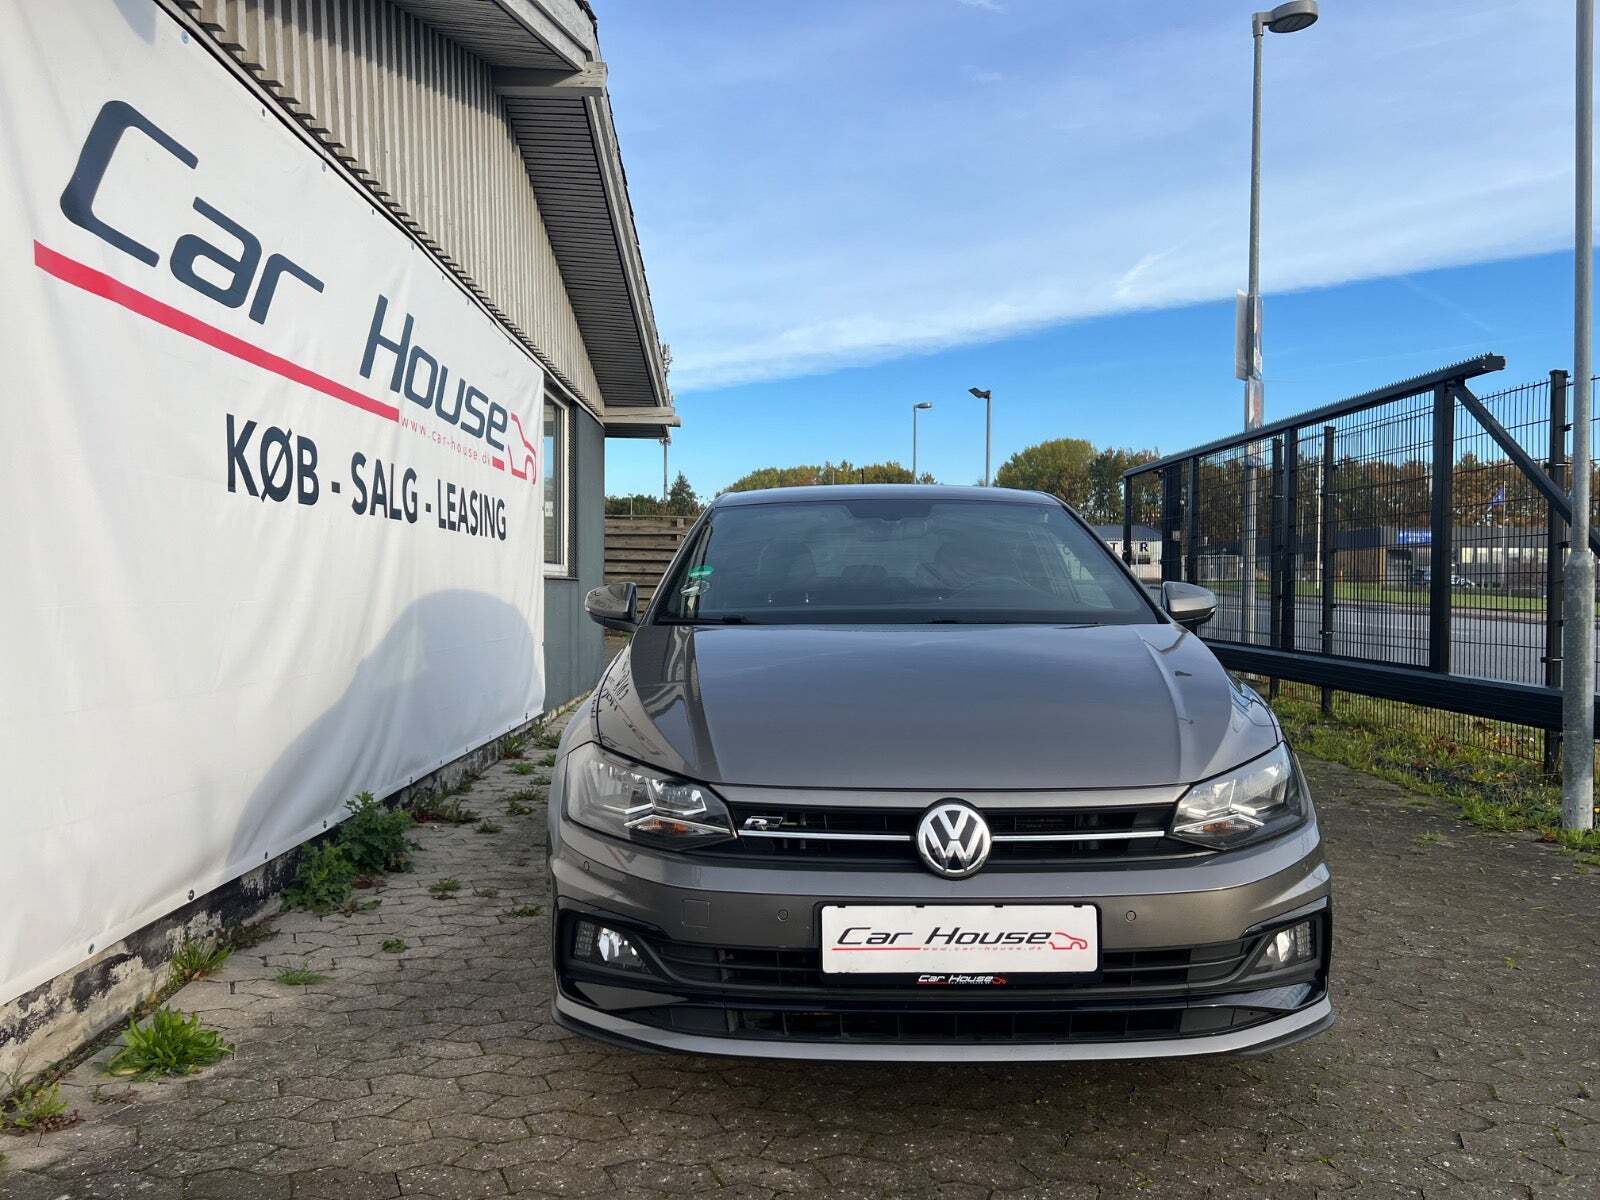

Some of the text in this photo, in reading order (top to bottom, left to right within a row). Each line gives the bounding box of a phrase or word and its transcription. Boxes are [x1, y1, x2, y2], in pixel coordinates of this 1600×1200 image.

[60, 100, 508, 452] Car House
[226, 413, 320, 506] KØB
[351, 451, 418, 524] SALG
[437, 479, 507, 541] LEASING
[837, 927, 1051, 945] Car House
[918, 974, 945, 983] Car
[949, 974, 993, 983] House
